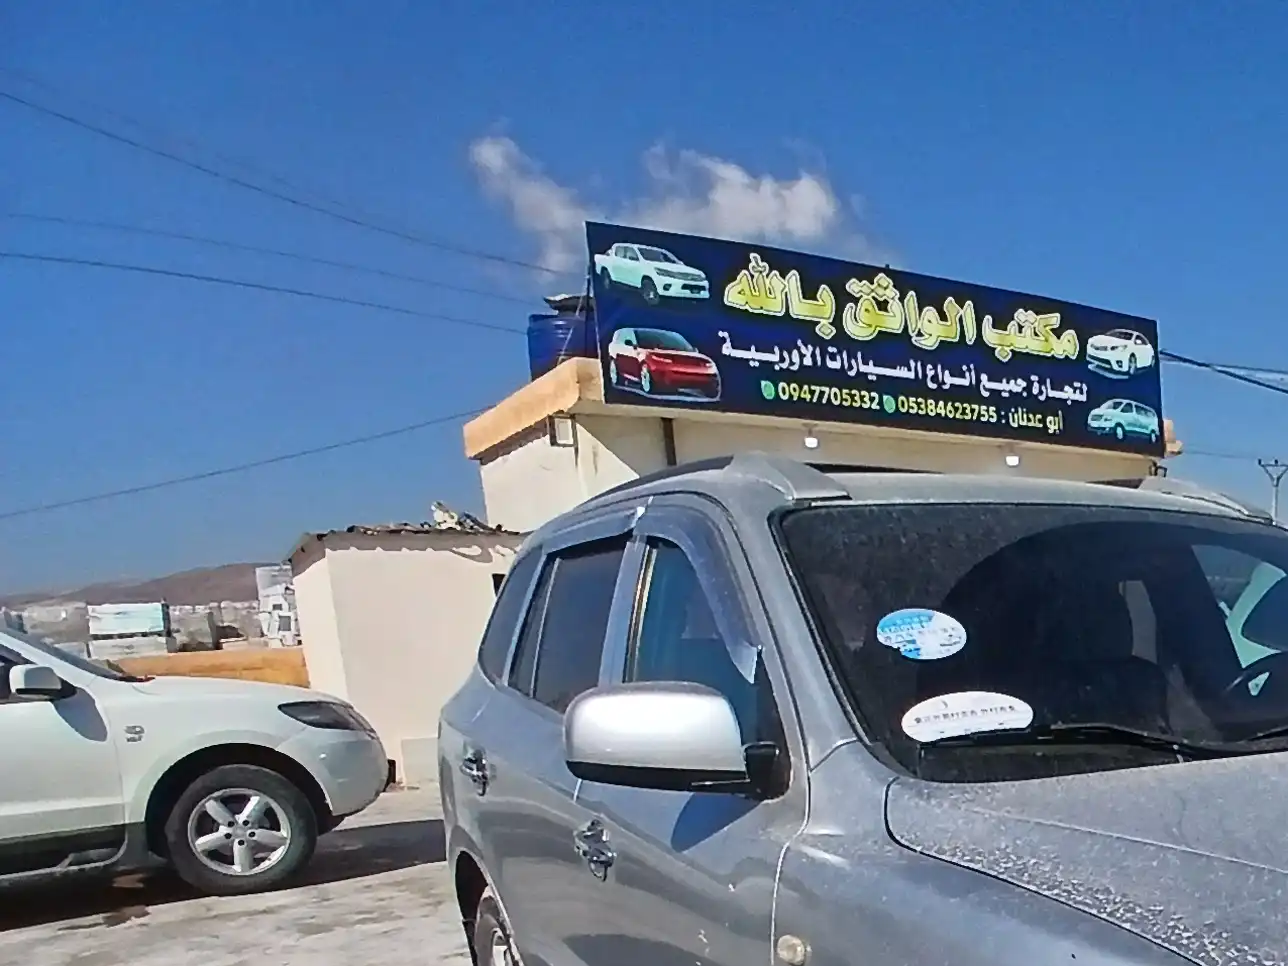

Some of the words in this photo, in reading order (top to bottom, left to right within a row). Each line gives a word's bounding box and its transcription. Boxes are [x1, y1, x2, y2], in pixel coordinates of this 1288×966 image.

[723, 252, 836, 340] بالله
[843, 272, 977, 350] الواثق
[981, 308, 1080, 363] مكتب
[825, 345, 923, 381] السيارات
[777, 381, 881, 411] 0947705332
[979, 372, 1028, 398] جميع
[1030, 374, 1088, 406] لتجارة
[897, 395, 998, 424] 05384623755
[1008, 406, 1045, 428] عدنان
